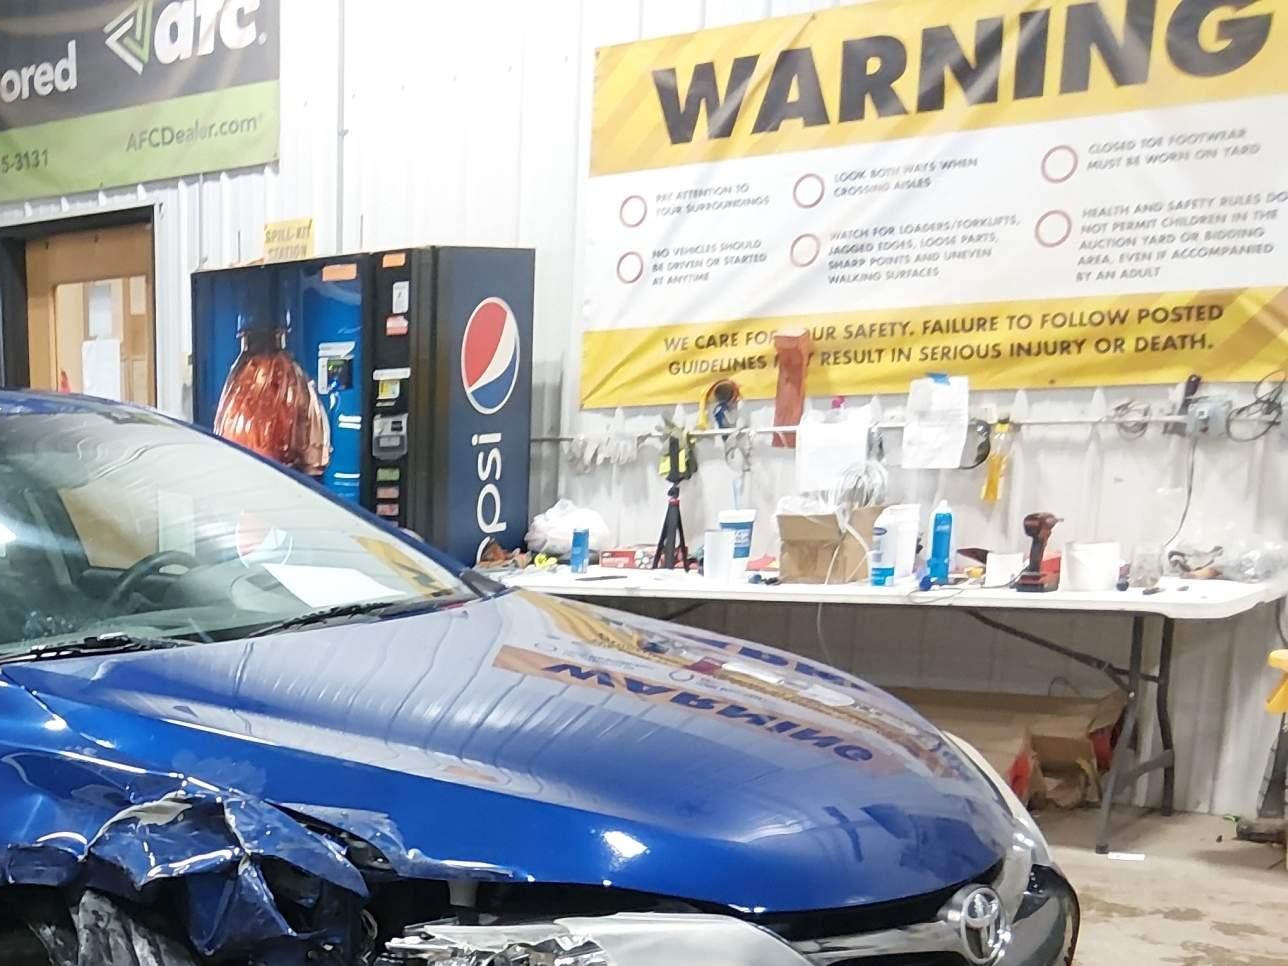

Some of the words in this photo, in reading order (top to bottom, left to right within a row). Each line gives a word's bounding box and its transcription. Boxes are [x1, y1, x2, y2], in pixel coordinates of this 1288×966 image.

[652, 0, 1273, 145] WARNING
[1088, 141, 1136, 154] CLOSED
[1141, 137, 1163, 149] TOE
[1168, 128, 1247, 146] FOOTWEAR
[1087, 158, 1121, 170] MUST
[1126, 155, 1140, 167] BE
[1146, 150, 1190, 164] WORN
[1195, 148, 1218, 160] ON
[1224, 143, 1261, 157] YARD
[834, 171, 865, 183] LOOK
[870, 167, 900, 179] BOTH
[941, 157, 979, 170] WHEN
[833, 184, 890, 197] CROSSING
[1082, 204, 1129, 218] HEALTH
[1134, 202, 1162, 214] AND
[1167, 197, 1216, 211] SAFETY
[1219, 193, 1261, 206] RULES
[830, 228, 869, 241] WATCH
[873, 226, 895, 237] FOR
[1081, 222, 1108, 234] NOT
[1112, 218, 1157, 232] PERMIT
[1161, 212, 1226, 228] CHILDREN
[1231, 211, 1247, 222] IN
[1253, 209, 1278, 220] THE
[828, 243, 873, 256] JAGGED
[920, 235, 956, 247] LOOSE
[1079, 235, 1136, 250] AUCTION
[1142, 232, 1175, 245] YARD
[1180, 231, 1199, 242] OR
[1204, 227, 1265, 241] BIDDING
[724, 253, 767, 266] STARTED
[828, 258, 865, 271] SHARP
[870, 255, 910, 267] POINTS
[914, 252, 940, 263] AND
[944, 248, 992, 261] UNEVEN
[1119, 250, 1152, 263] EVEN
[1171, 243, 1274, 260] ACCOMPANIED
[828, 270, 881, 284] WALKING
[886, 267, 939, 280] SURFACES
[1076, 270, 1091, 281] BY
[1096, 269, 1115, 280] AN
[1120, 267, 1160, 279] ADULT
[664, 335, 688, 352] WE
[695, 331, 738, 349] CARE
[844, 320, 914, 340] SAFETY.
[922, 316, 998, 335] FAILURE
[1007, 314, 1032, 331] TO
[1040, 308, 1129, 329] FOLLOW
[1137, 304, 1224, 324] POSTED
[668, 357, 767, 376] GUIDELINES
[820, 349, 883, 367] RESULT
[891, 346, 912, 363] IN
[918, 343, 1002, 362] SERIOUS
[1010, 339, 1088, 358] INJURY
[1094, 336, 1126, 354] OR
[1134, 333, 1214, 353] DEATH.
[471, 432, 506, 564] psi
